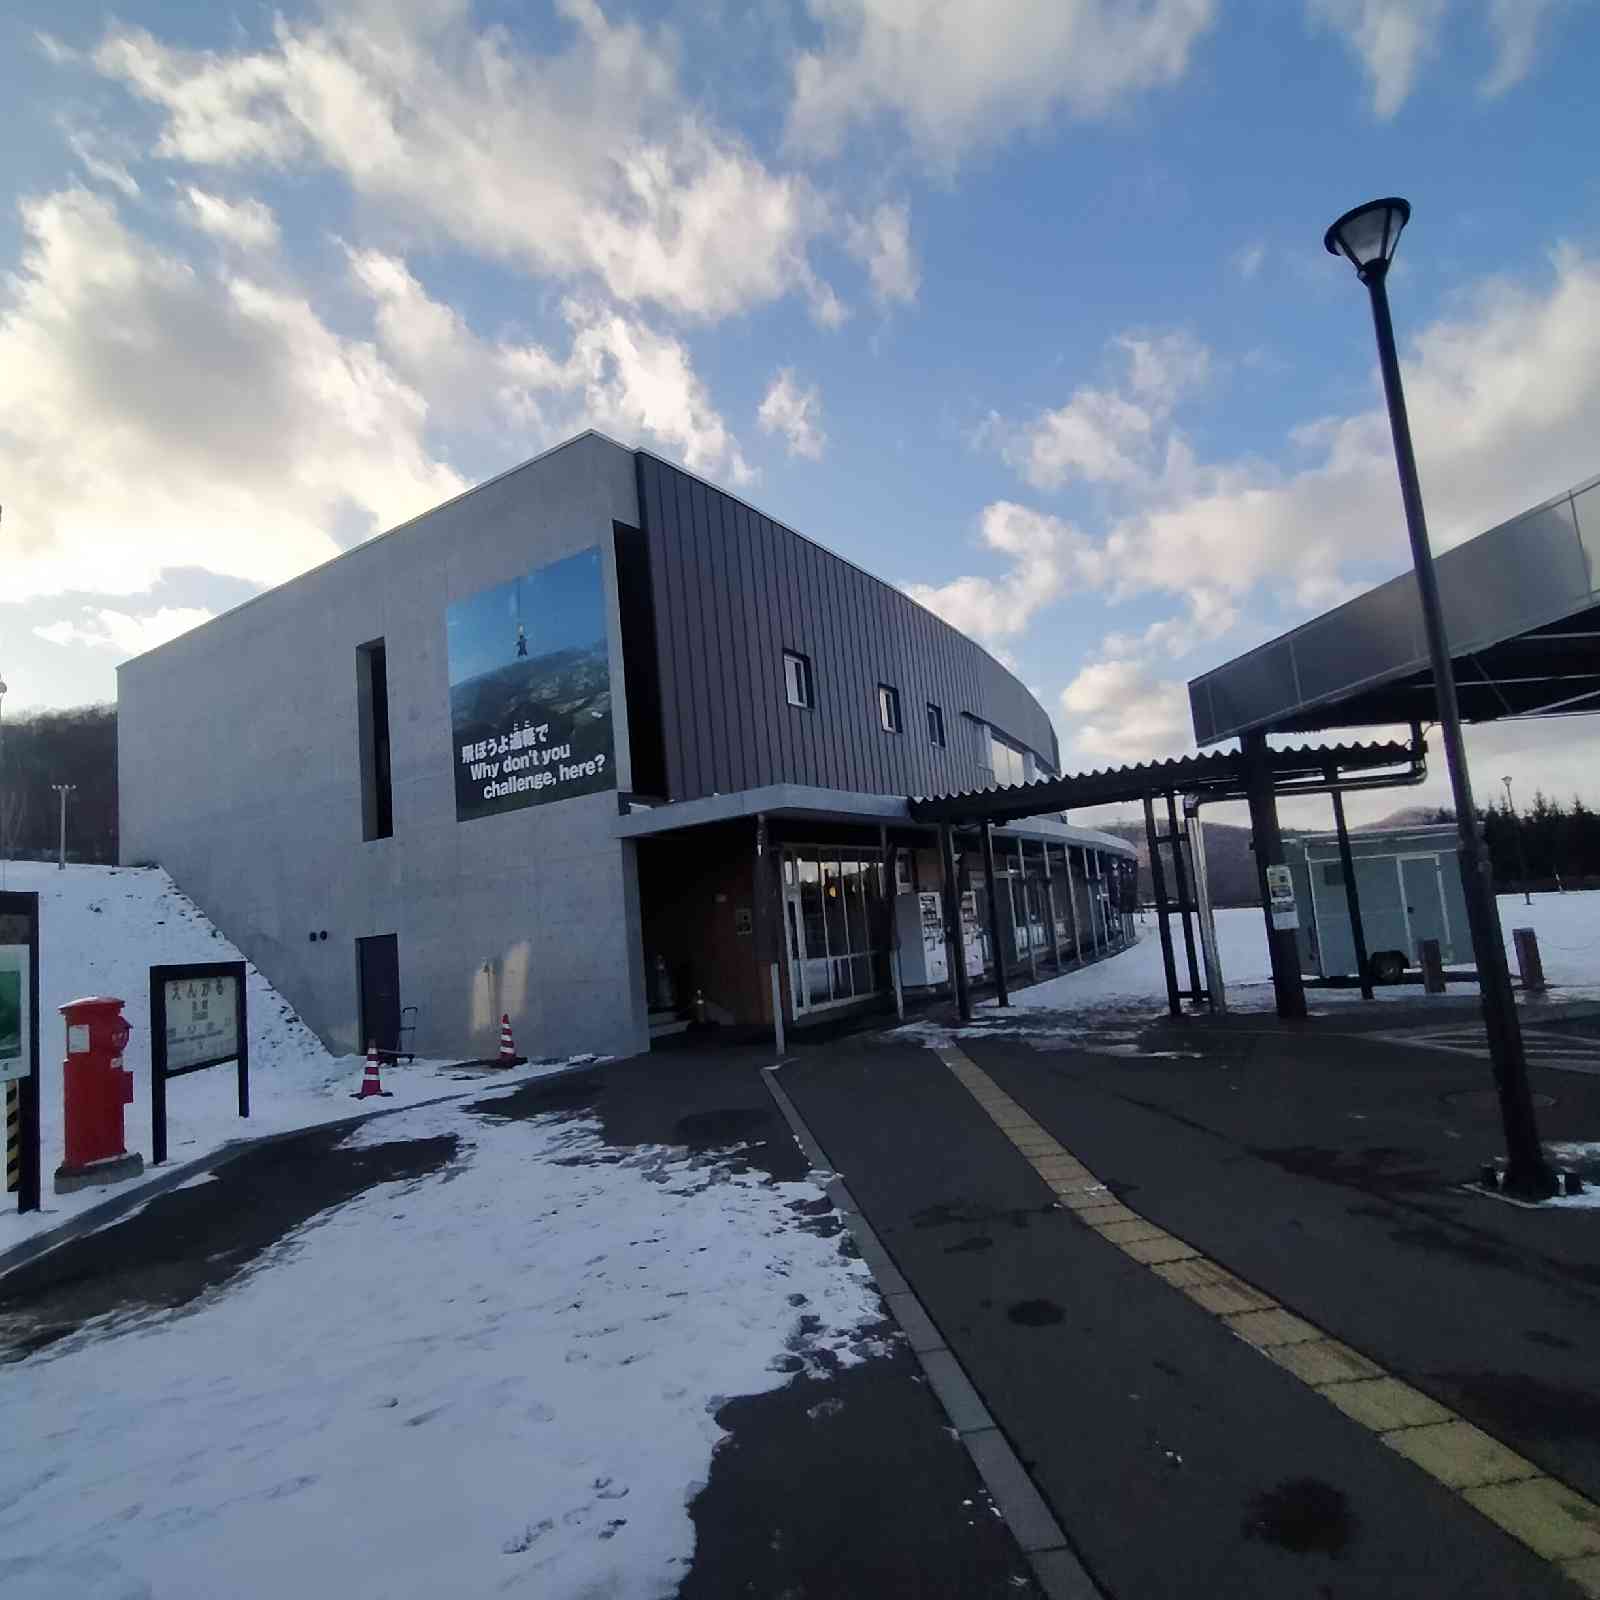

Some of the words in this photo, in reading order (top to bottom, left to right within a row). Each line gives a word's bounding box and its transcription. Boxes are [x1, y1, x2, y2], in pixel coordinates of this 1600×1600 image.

[470, 762, 500, 781] Why
[503, 749, 540, 774] don't
[541, 743, 571, 766] you
[483, 771, 557, 799] challenge,
[560, 753, 606, 781] here?
